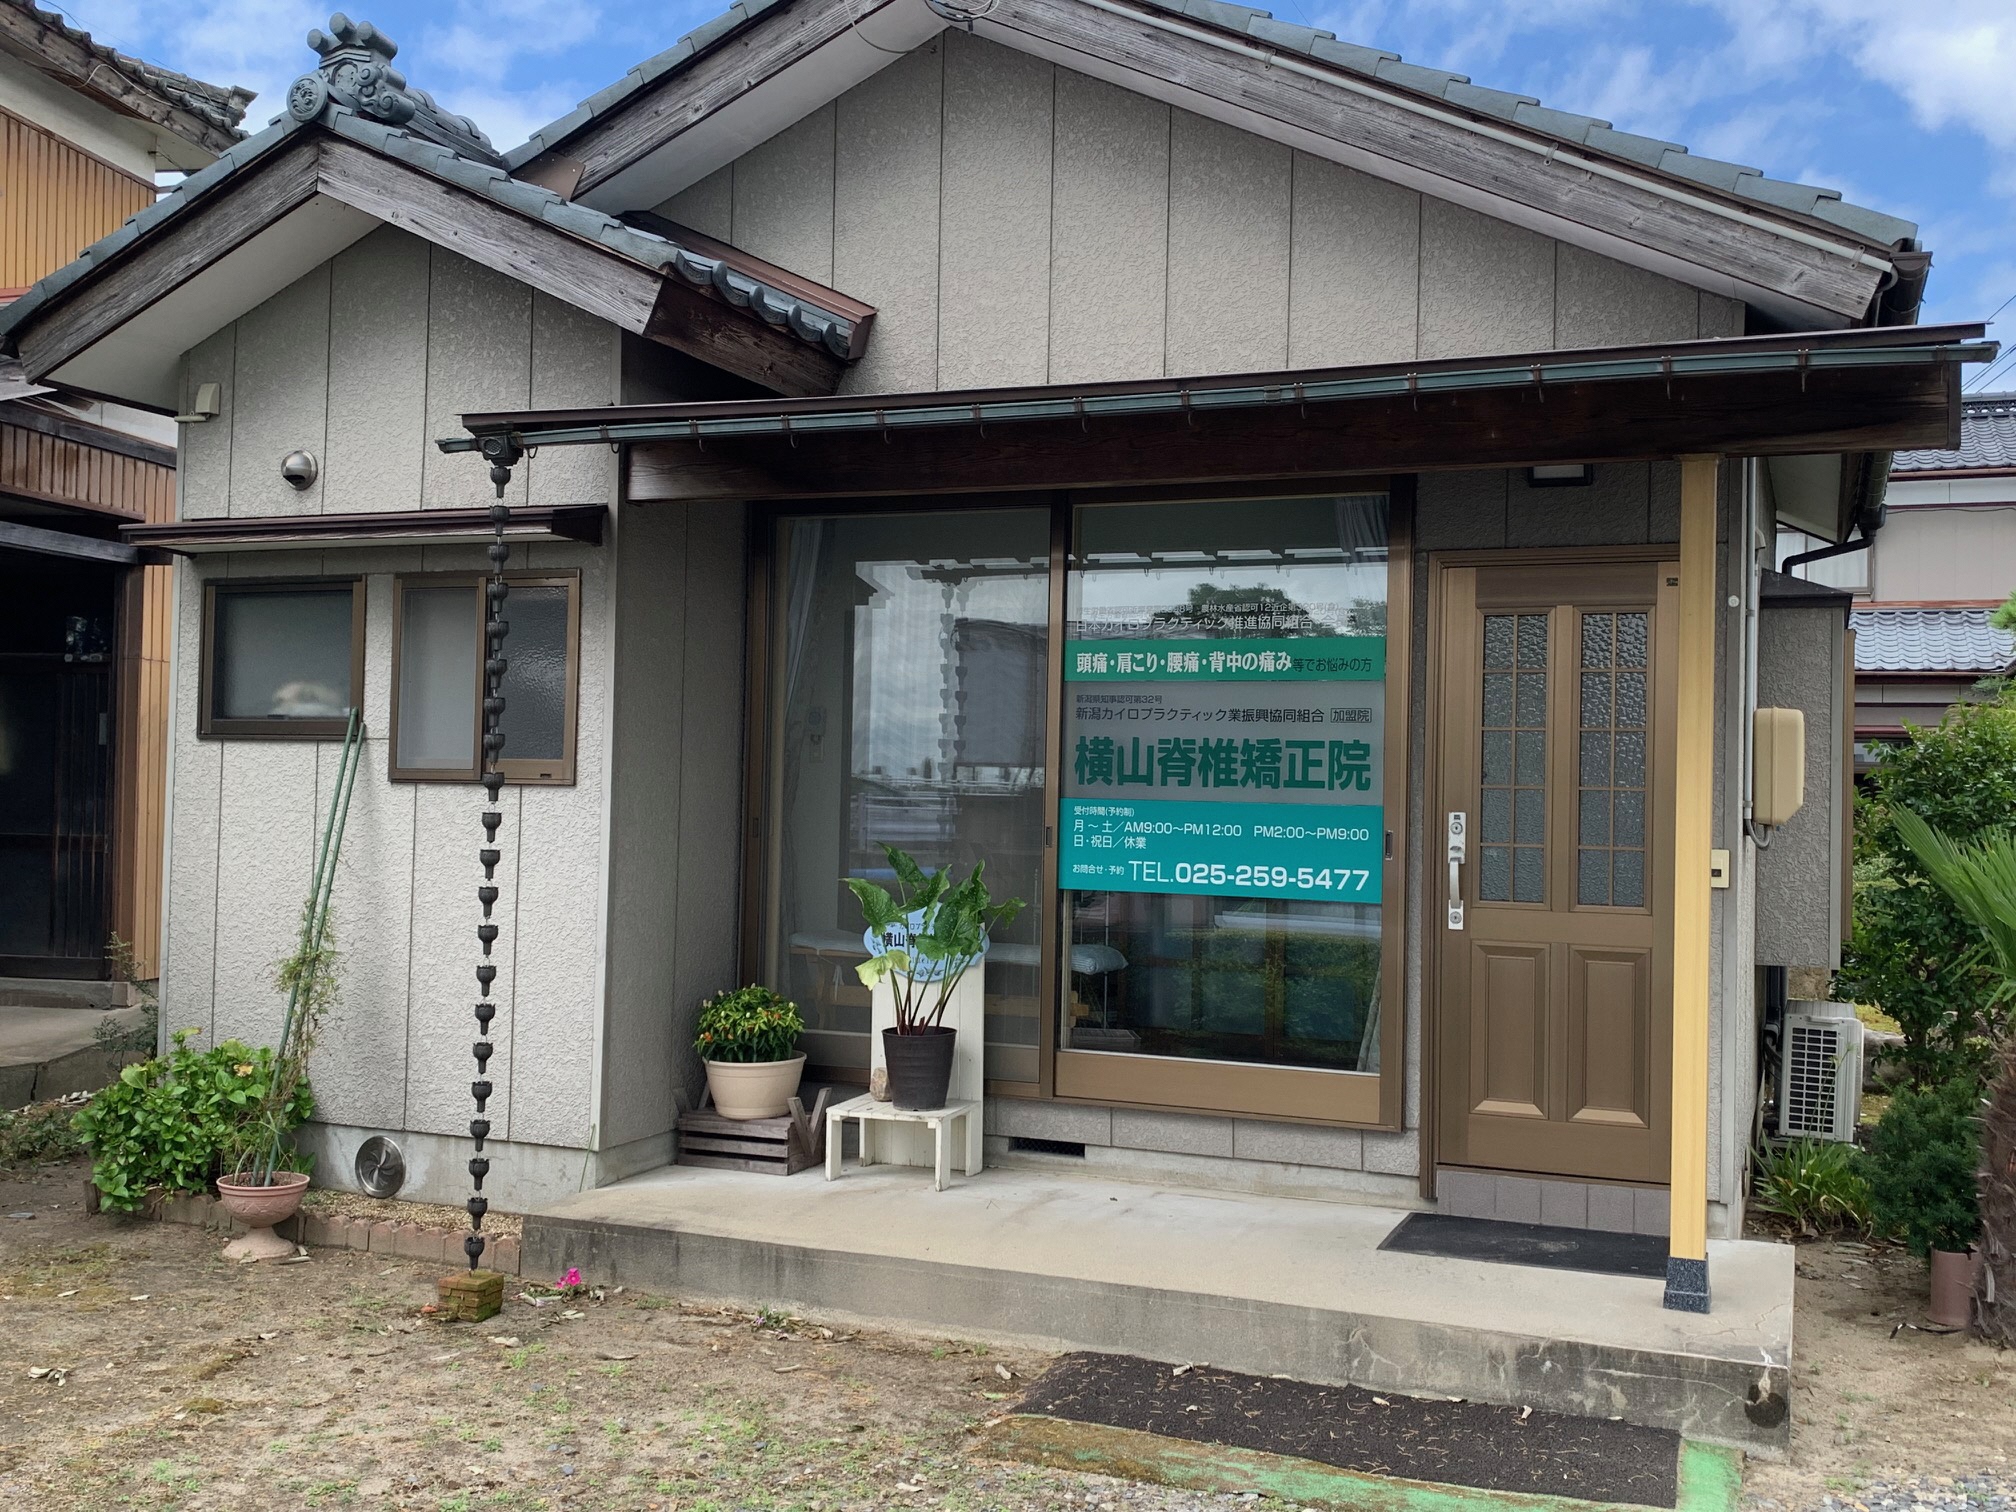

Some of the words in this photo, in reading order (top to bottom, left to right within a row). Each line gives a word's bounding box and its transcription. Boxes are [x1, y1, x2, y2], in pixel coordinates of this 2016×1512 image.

[1075, 706, 1325, 724] 新潟カイロプラクティック業振興協同組合
[1332, 709, 1371, 723] 加盟院
[1074, 735, 1372, 791] 横山脊椎矯正院
[1073, 806, 1135, 817] 受付時間(予約制)
